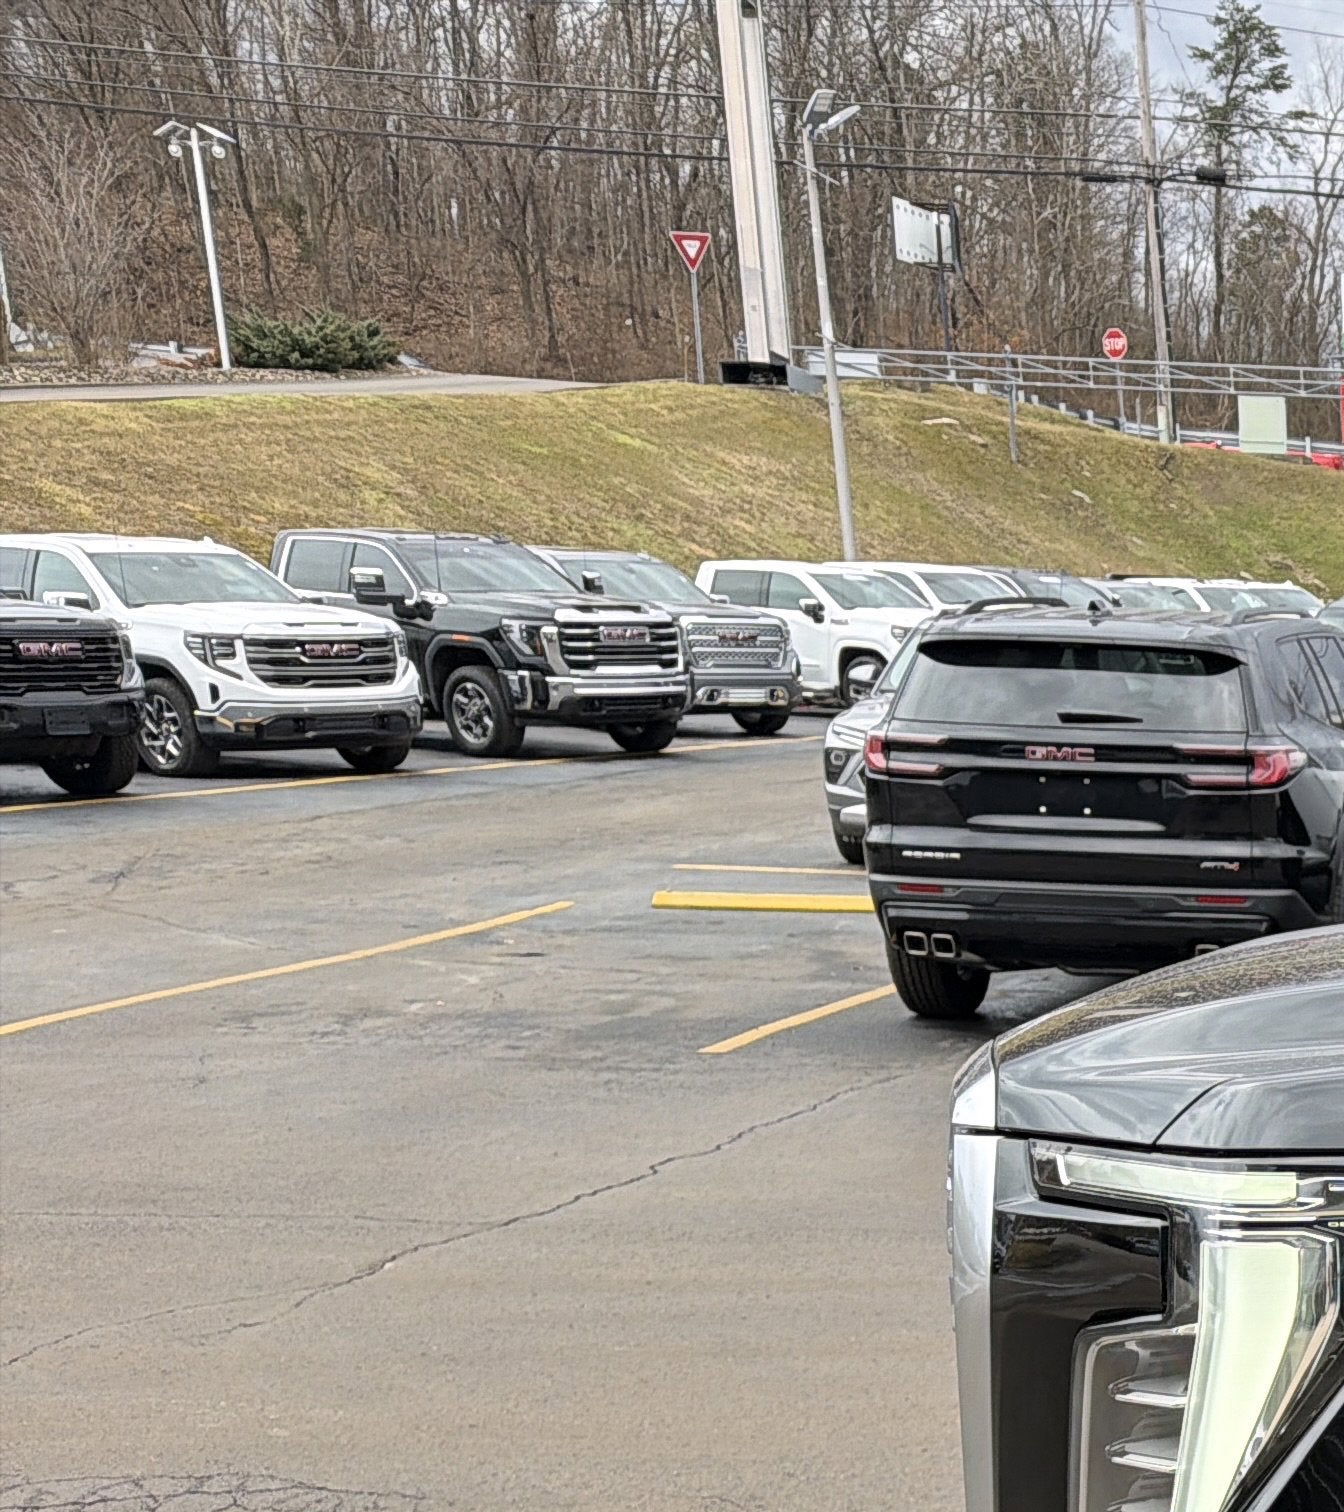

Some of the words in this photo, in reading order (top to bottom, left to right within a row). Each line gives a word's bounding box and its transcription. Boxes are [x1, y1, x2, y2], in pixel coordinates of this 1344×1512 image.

[1103, 338, 1126, 351] STOP
[19, 642, 82, 656] GMC
[304, 643, 360, 656] GMC
[1025, 746, 1095, 762] GMC
